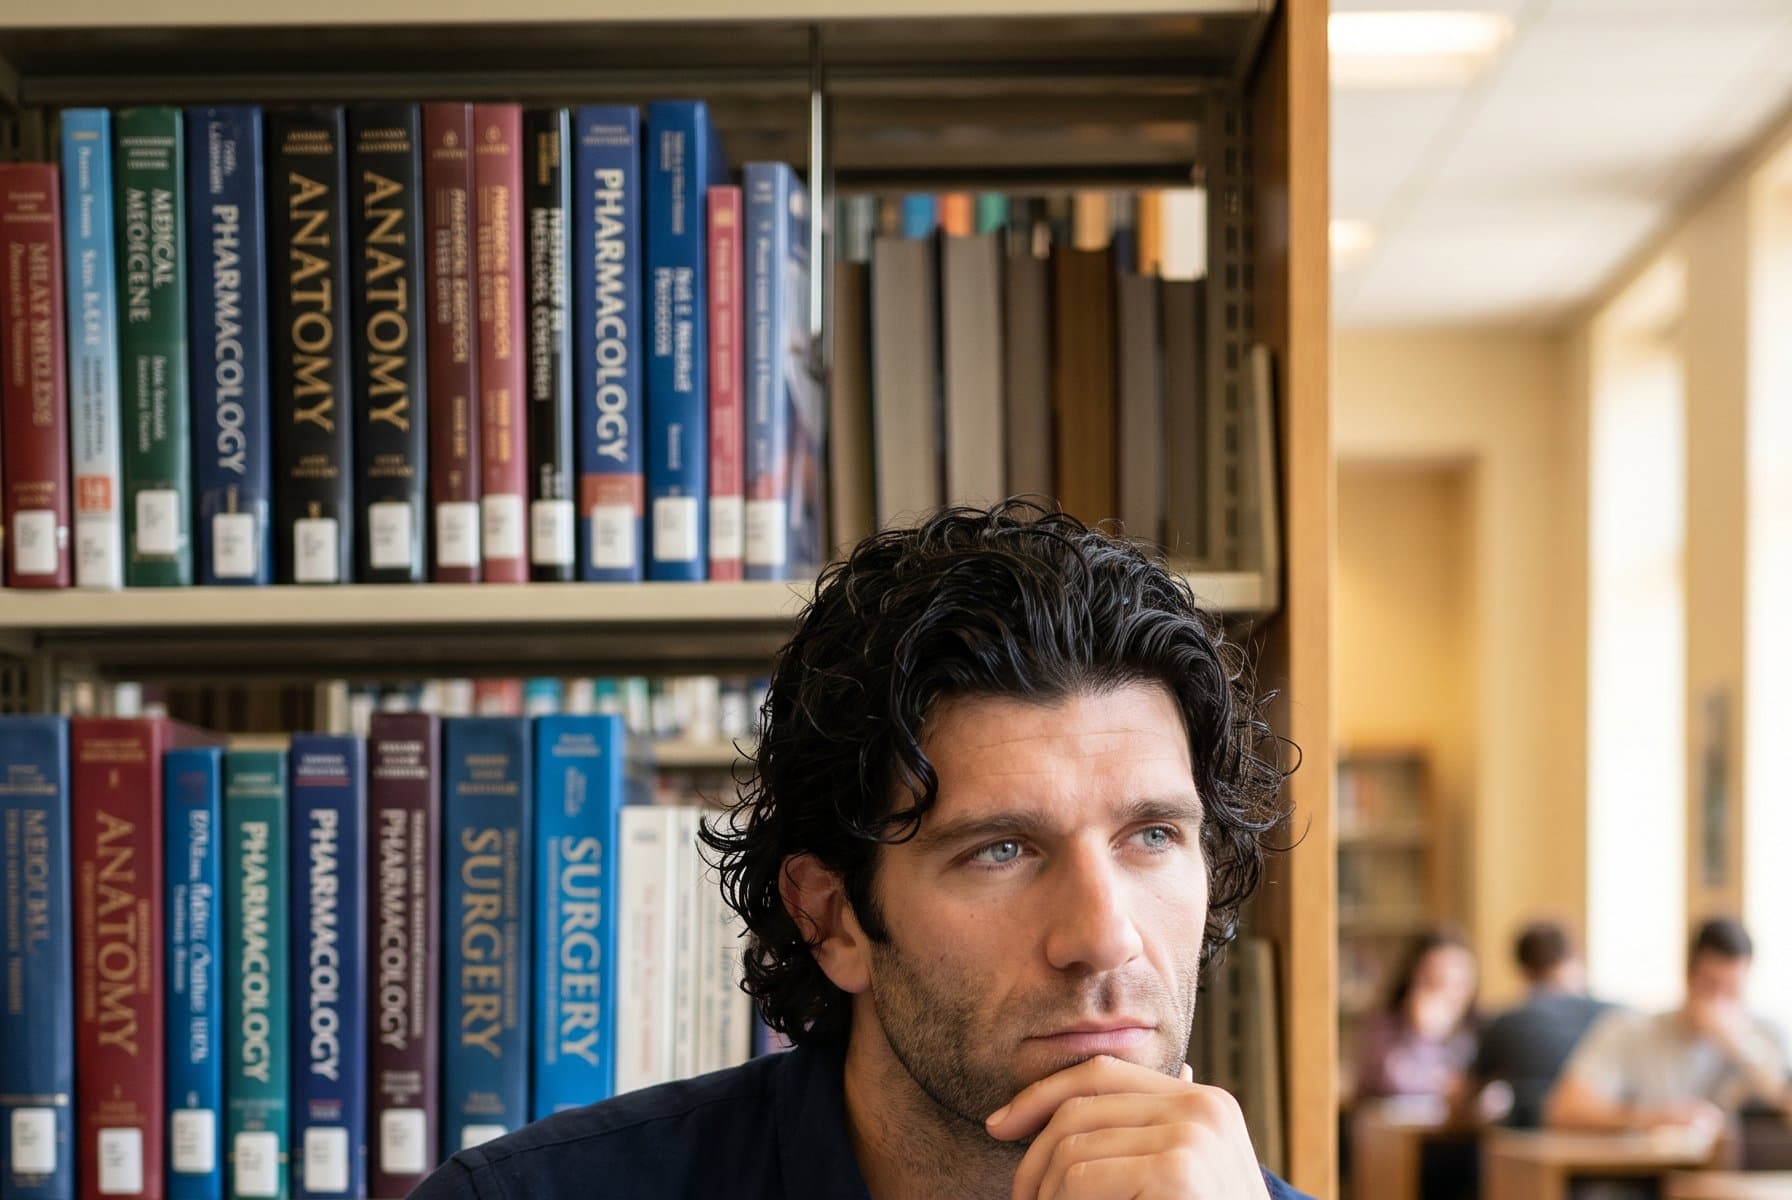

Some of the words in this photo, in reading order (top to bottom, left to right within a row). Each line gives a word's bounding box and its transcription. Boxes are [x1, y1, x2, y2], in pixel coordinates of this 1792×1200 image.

[212, 205, 246, 475] PHARMACOLOGY
[290, 173, 336, 432] ANATOMY
[364, 172, 409, 431] ANATOMY
[595, 169, 628, 463] PHARMACOLOGY
[96, 811, 137, 1056] ANATOMY
[241, 822, 270, 1082] PHARMACOLOGY
[310, 809, 341, 1081] PHARMACOLOGY
[380, 809, 407, 1049] PHARMACOLOGY
[462, 828, 501, 1059] SURGERY
[562, 835, 601, 1065] SURGERY
